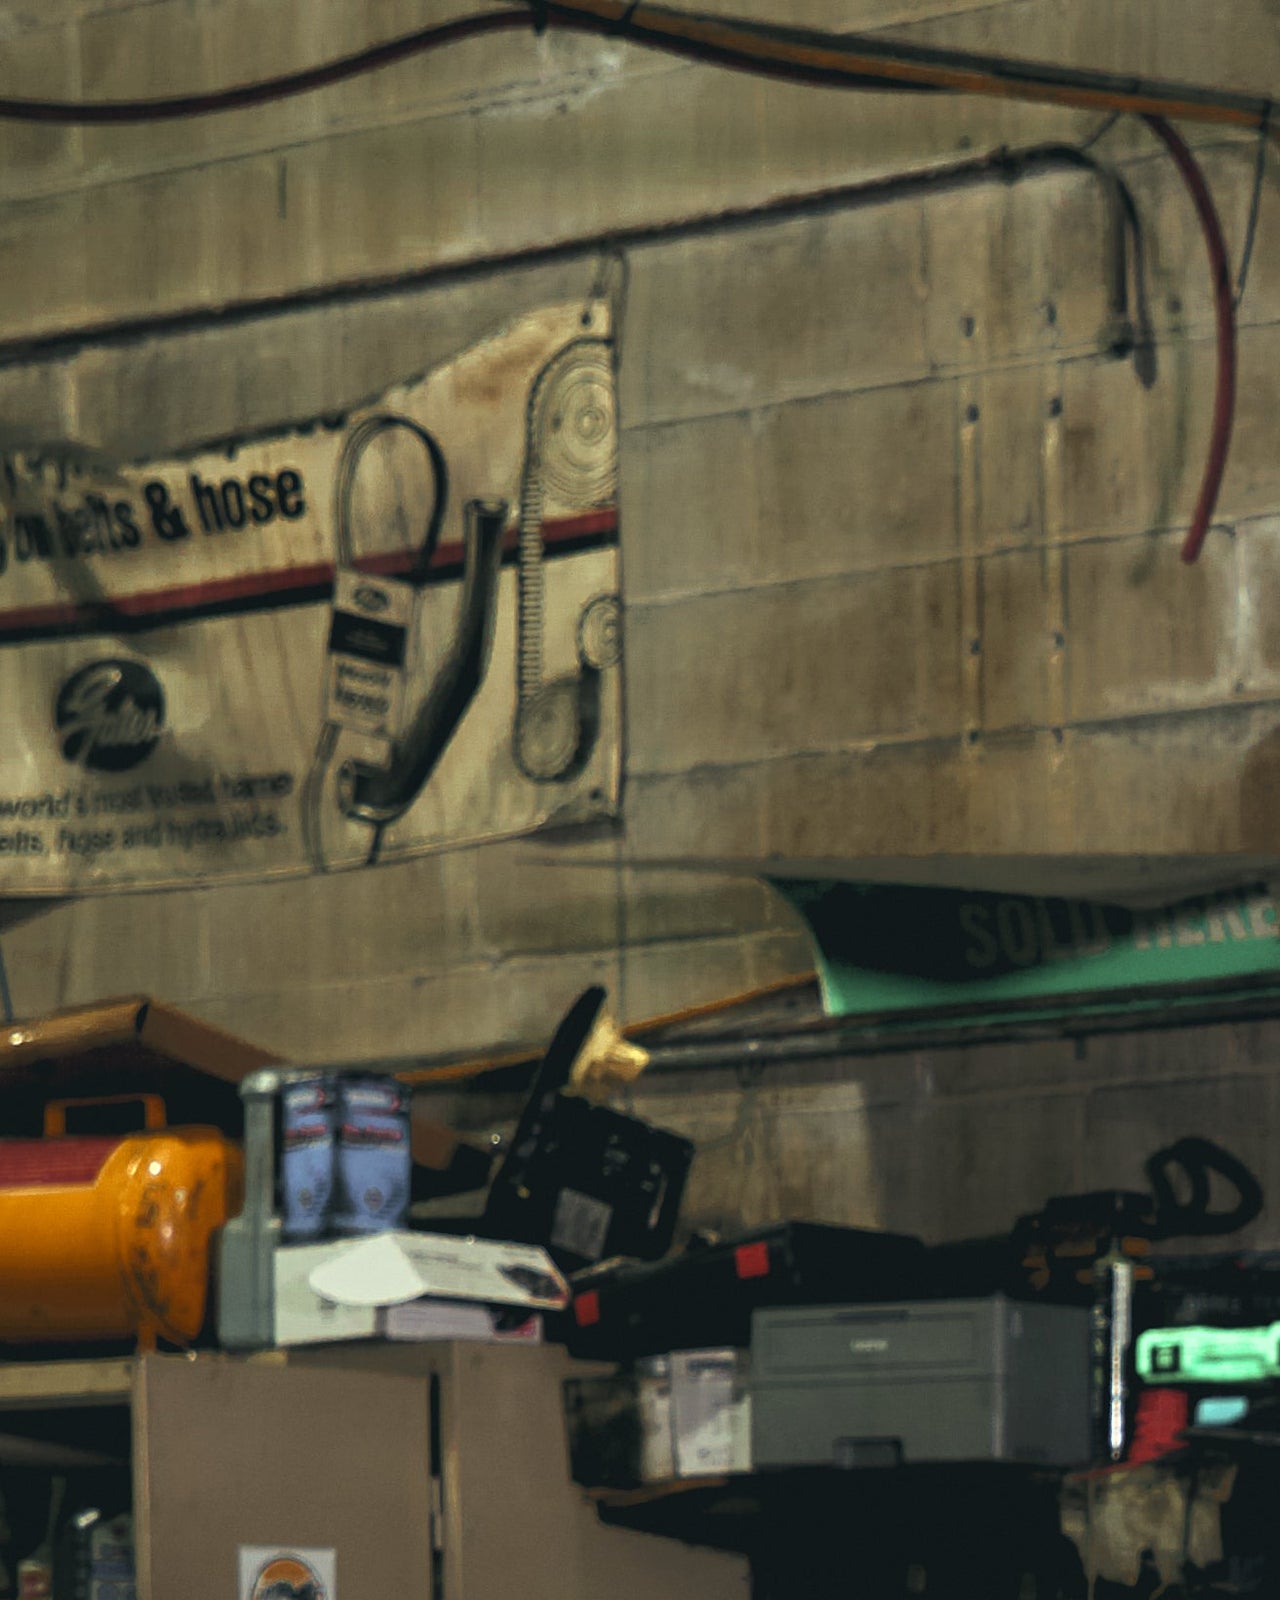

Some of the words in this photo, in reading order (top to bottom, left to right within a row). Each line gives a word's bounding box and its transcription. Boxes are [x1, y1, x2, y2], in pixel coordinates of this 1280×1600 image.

[144, 480, 190, 542] &
[191, 467, 306, 534] hose
[958, 895, 1118, 970] SOLD
